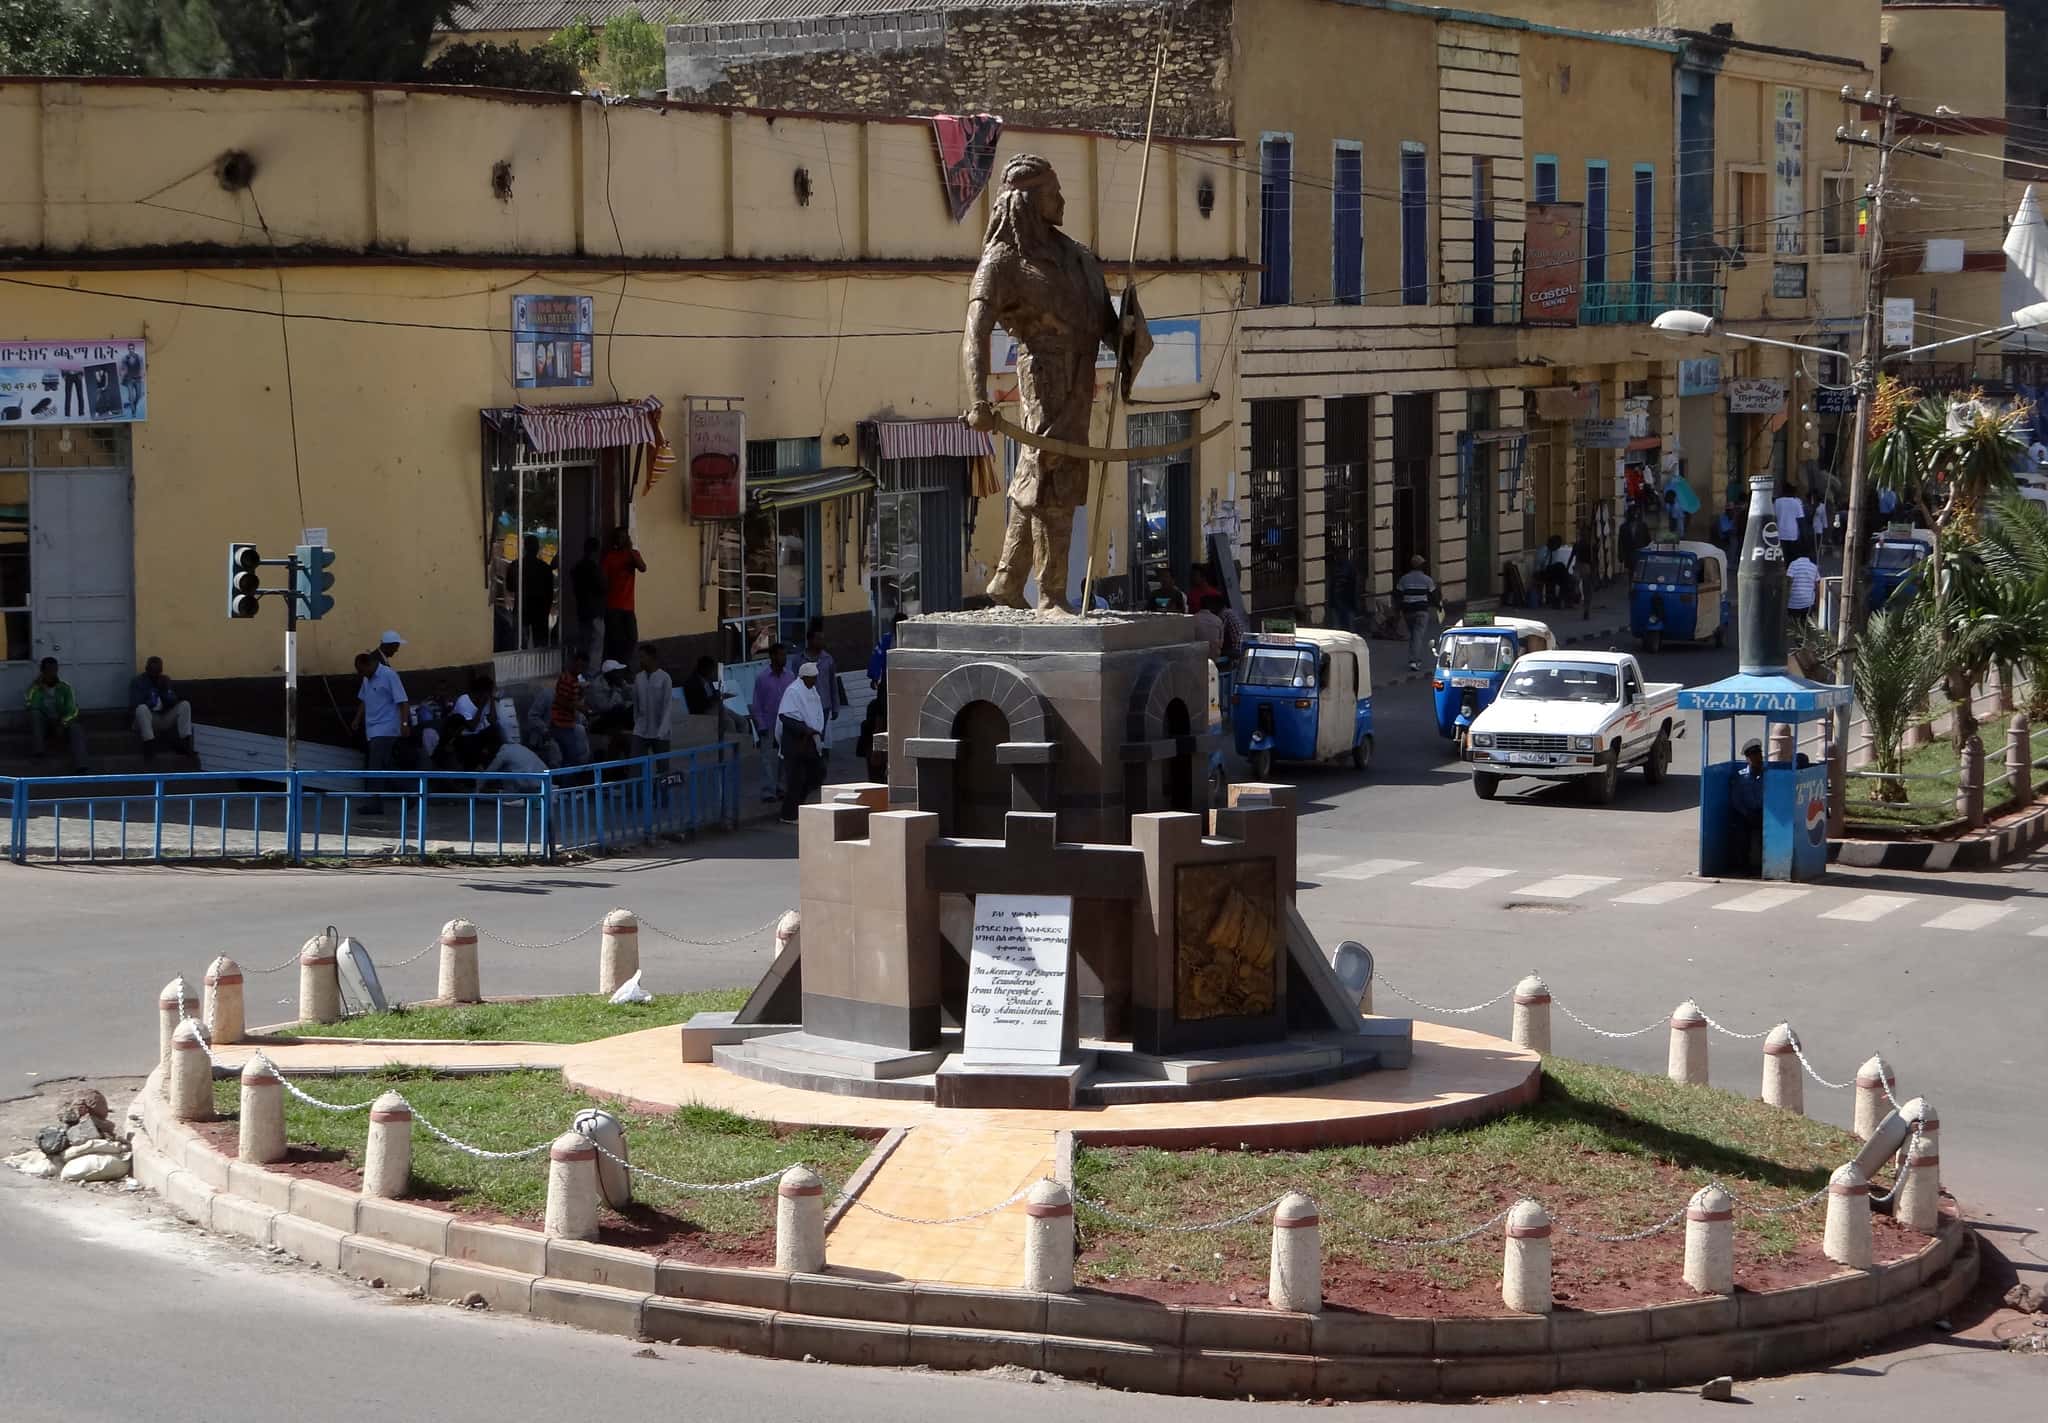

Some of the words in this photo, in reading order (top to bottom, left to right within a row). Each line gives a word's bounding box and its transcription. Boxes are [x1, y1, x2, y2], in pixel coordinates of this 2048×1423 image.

[94, 346, 118, 360] ቤት
[985, 967, 1023, 978] Memory
[970, 986, 992, 994] from
[993, 986, 1006, 995] the
[971, 1003, 991, 1017] City
